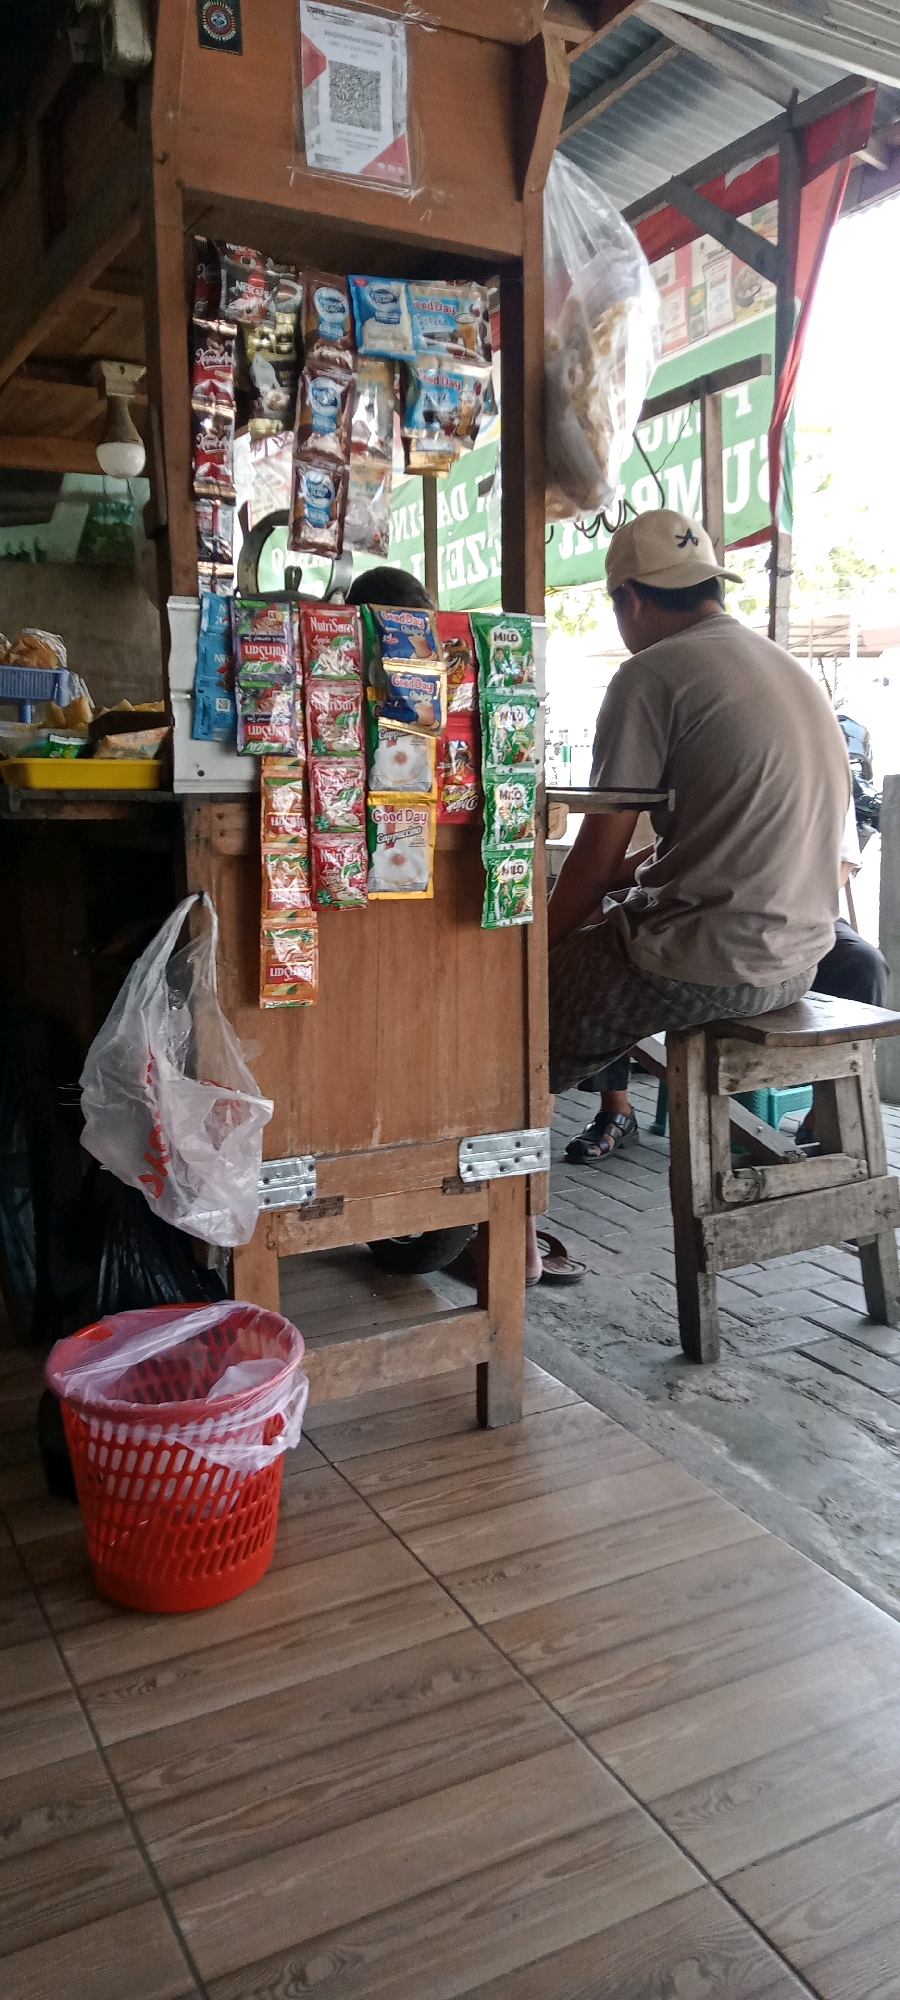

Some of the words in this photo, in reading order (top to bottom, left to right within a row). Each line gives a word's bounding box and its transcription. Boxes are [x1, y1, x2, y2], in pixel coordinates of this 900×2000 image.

[493, 632, 519, 643] MILO
[391, 674, 413, 688] Good
[413, 677, 435, 694] Day
[372, 809, 403, 824] Good
[405, 809, 428, 827] Day
[376, 826, 423, 844] Cappuccino
[501, 864, 524, 876] MILO
